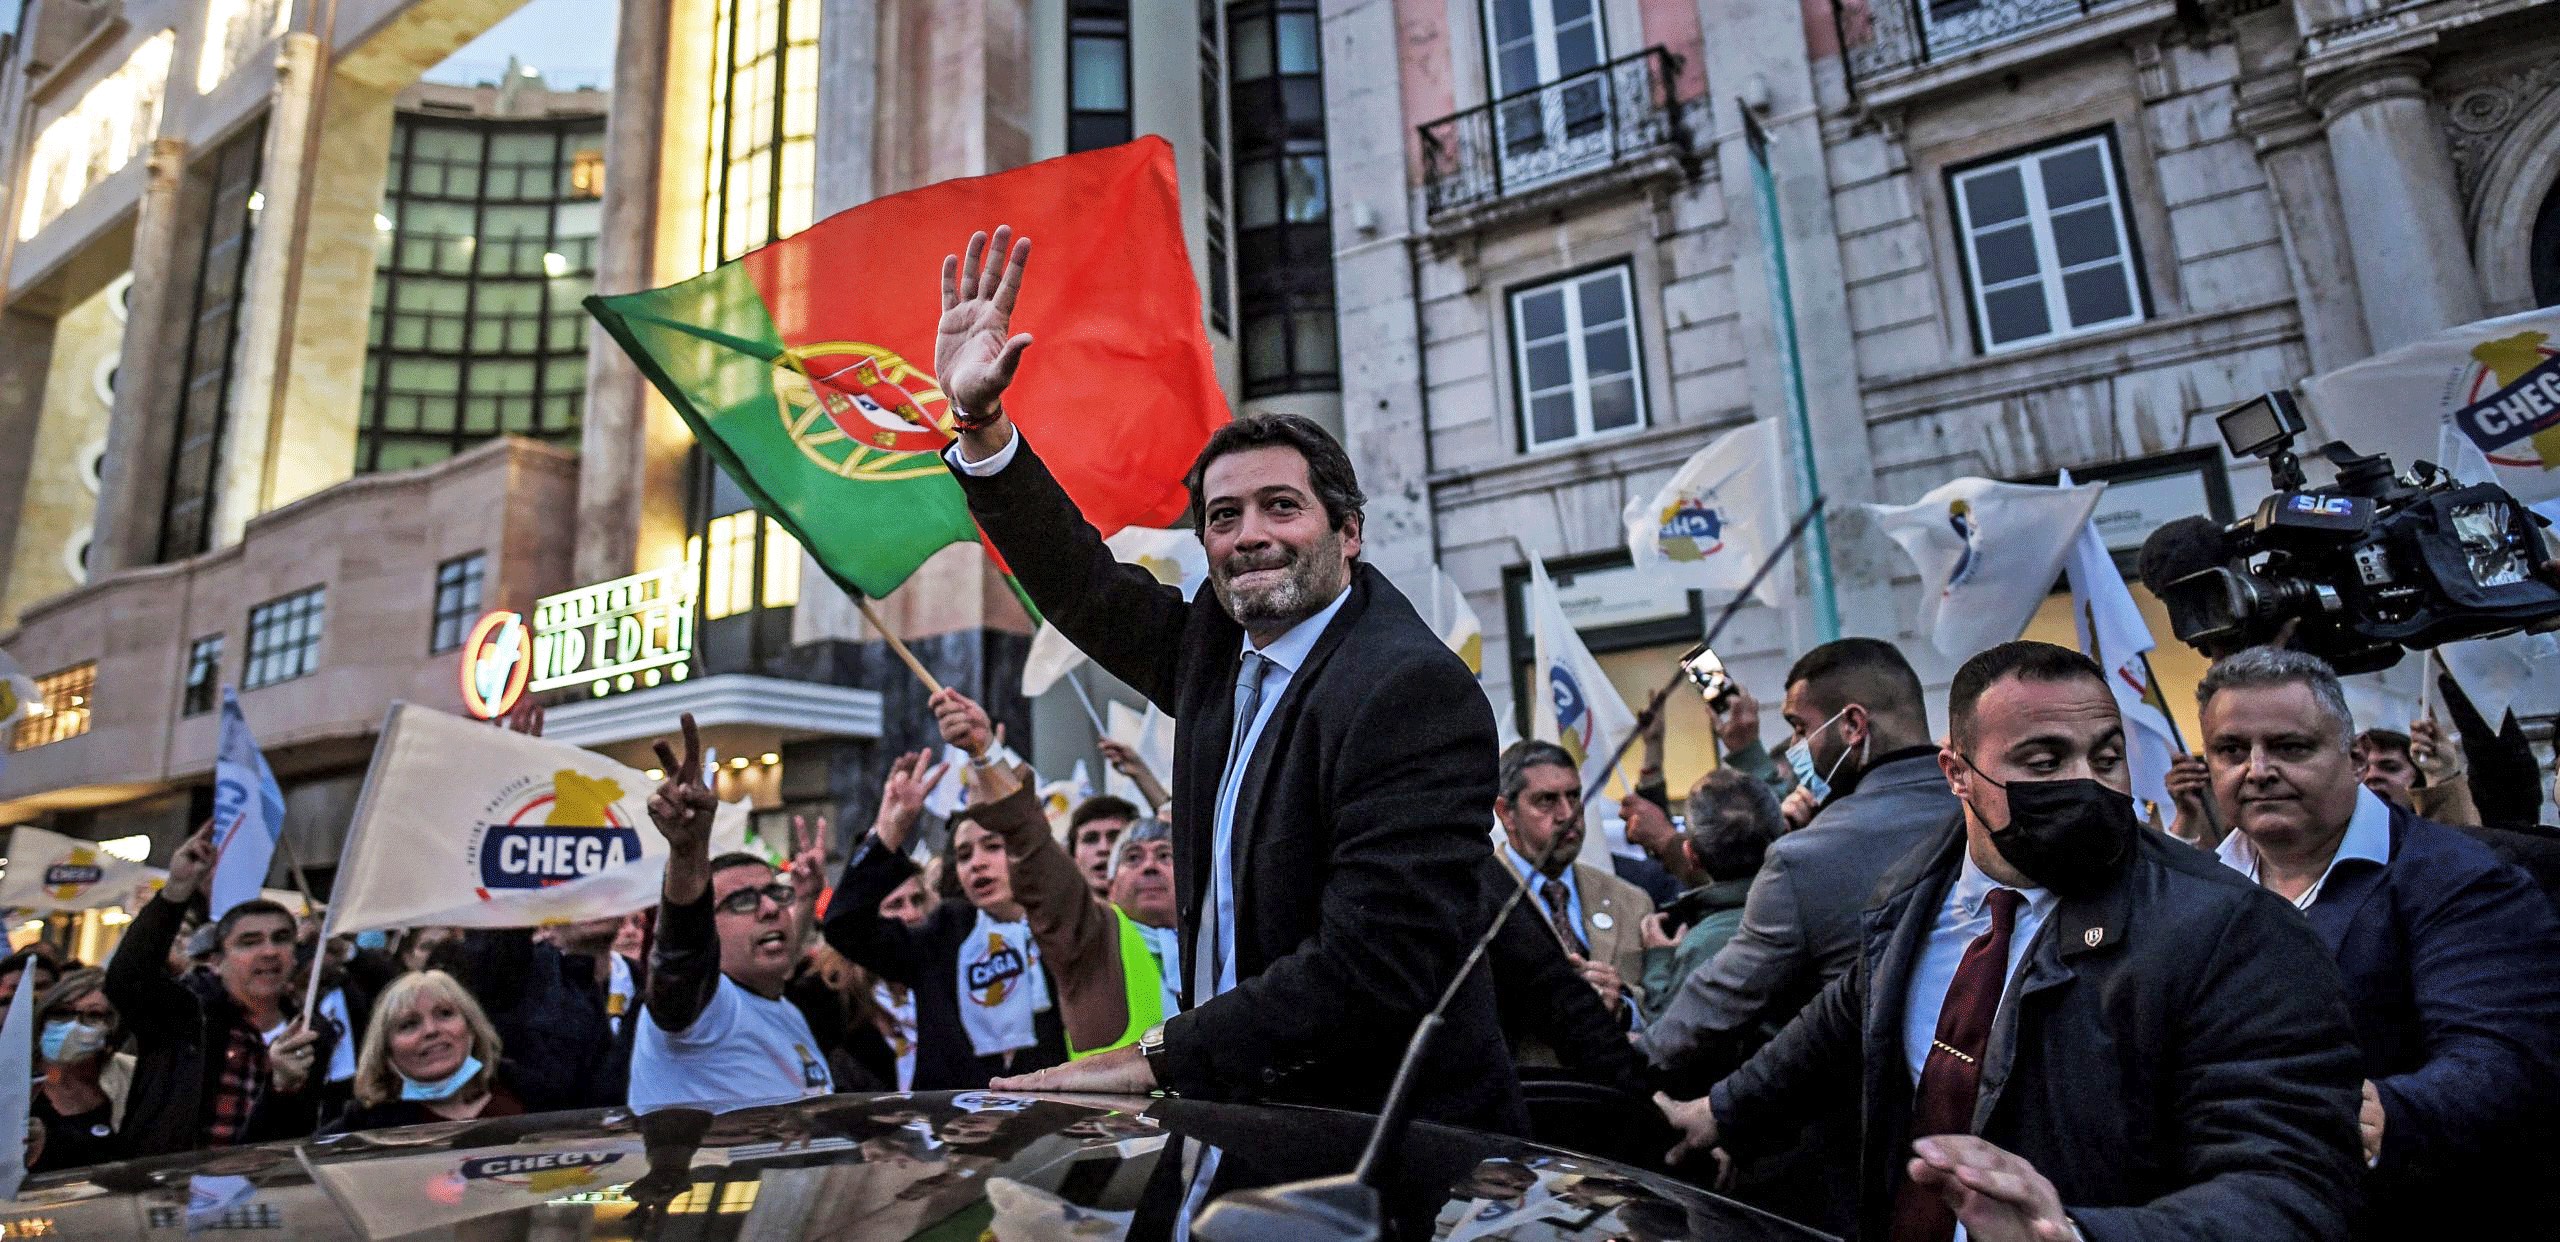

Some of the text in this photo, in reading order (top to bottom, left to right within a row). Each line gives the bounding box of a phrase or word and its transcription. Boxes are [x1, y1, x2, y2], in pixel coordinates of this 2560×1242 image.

[2474, 361, 2560, 435] CHEG
[592, 599, 695, 668] EDEN
[501, 834, 627, 875] CHEGA
